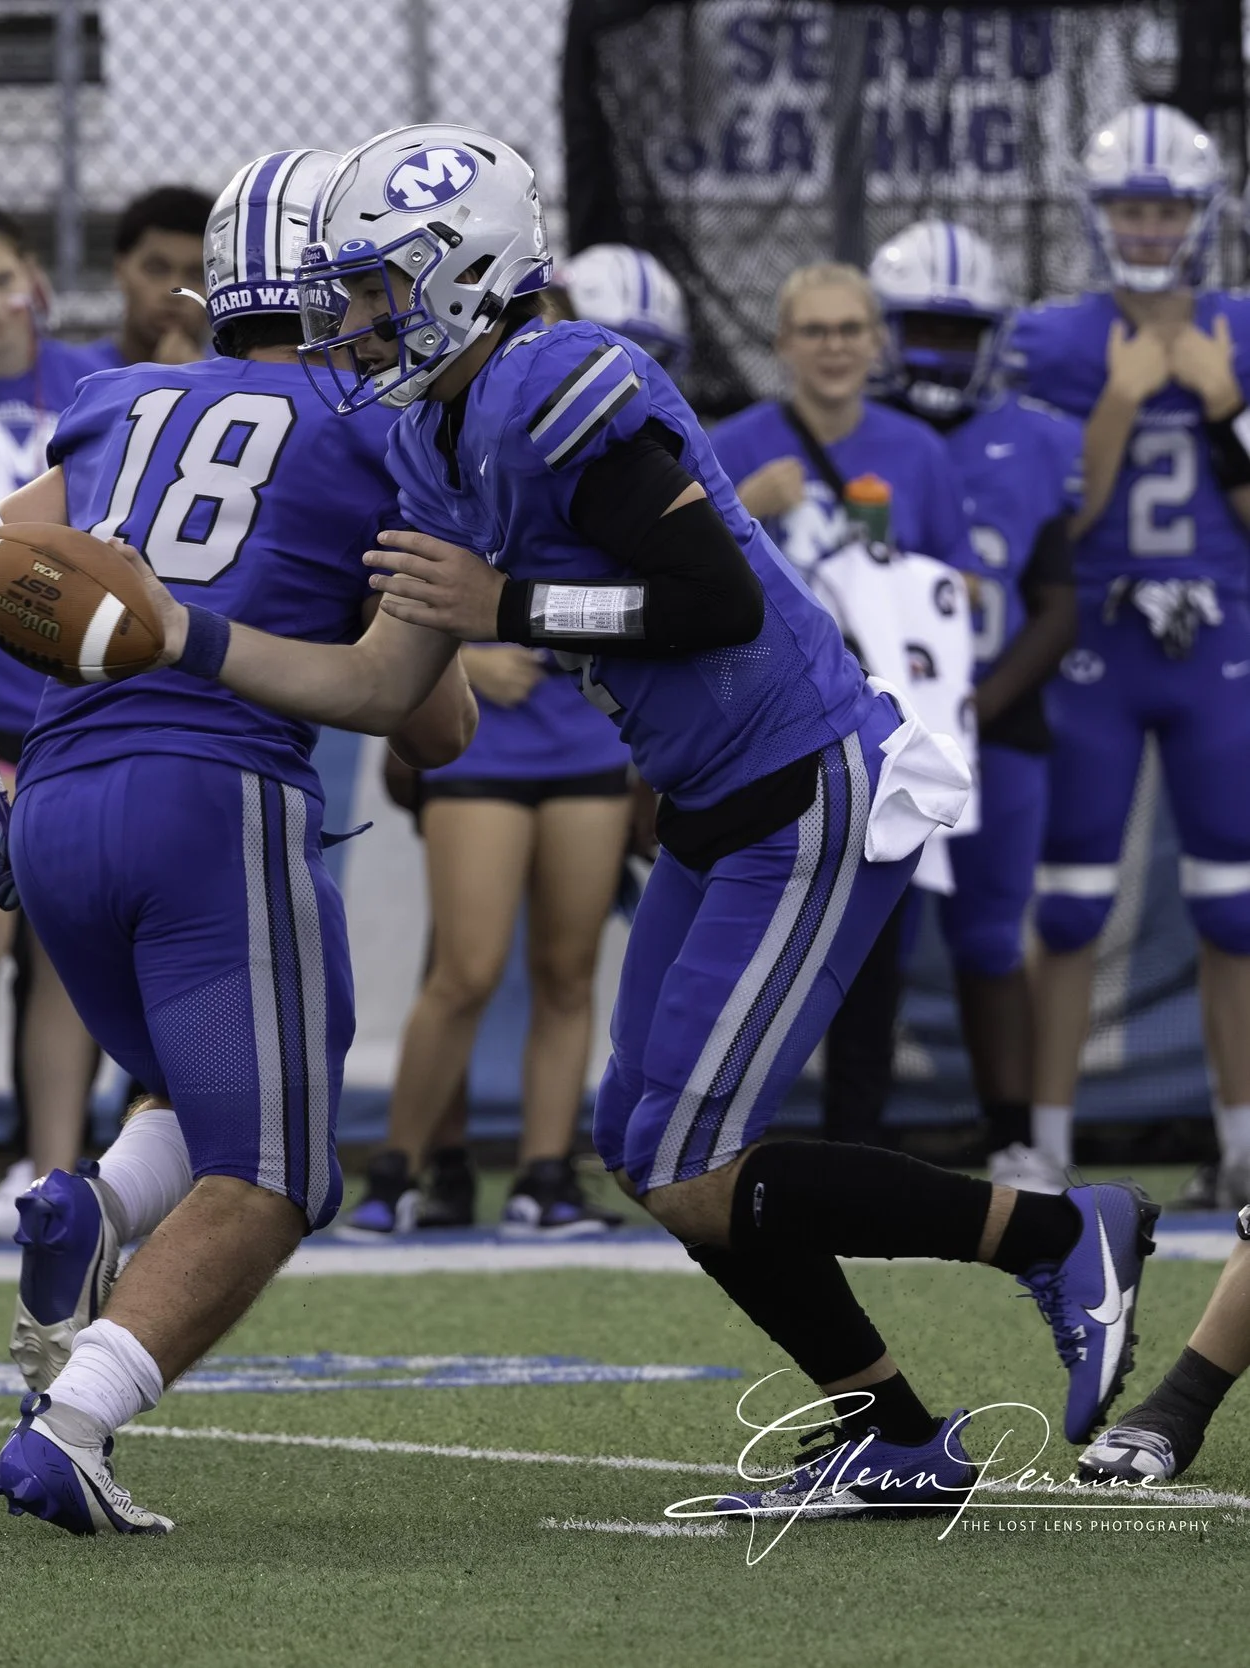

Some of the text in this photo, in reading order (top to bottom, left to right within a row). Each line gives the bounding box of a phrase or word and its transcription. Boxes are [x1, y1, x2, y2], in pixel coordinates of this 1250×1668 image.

[390, 149, 473, 208] M
[210, 289, 252, 316] HARD
[84, 386, 298, 587] 18
[1129, 429, 1197, 557] 2
[12, 575, 62, 600] GST
[32, 560, 63, 581] NCAA
